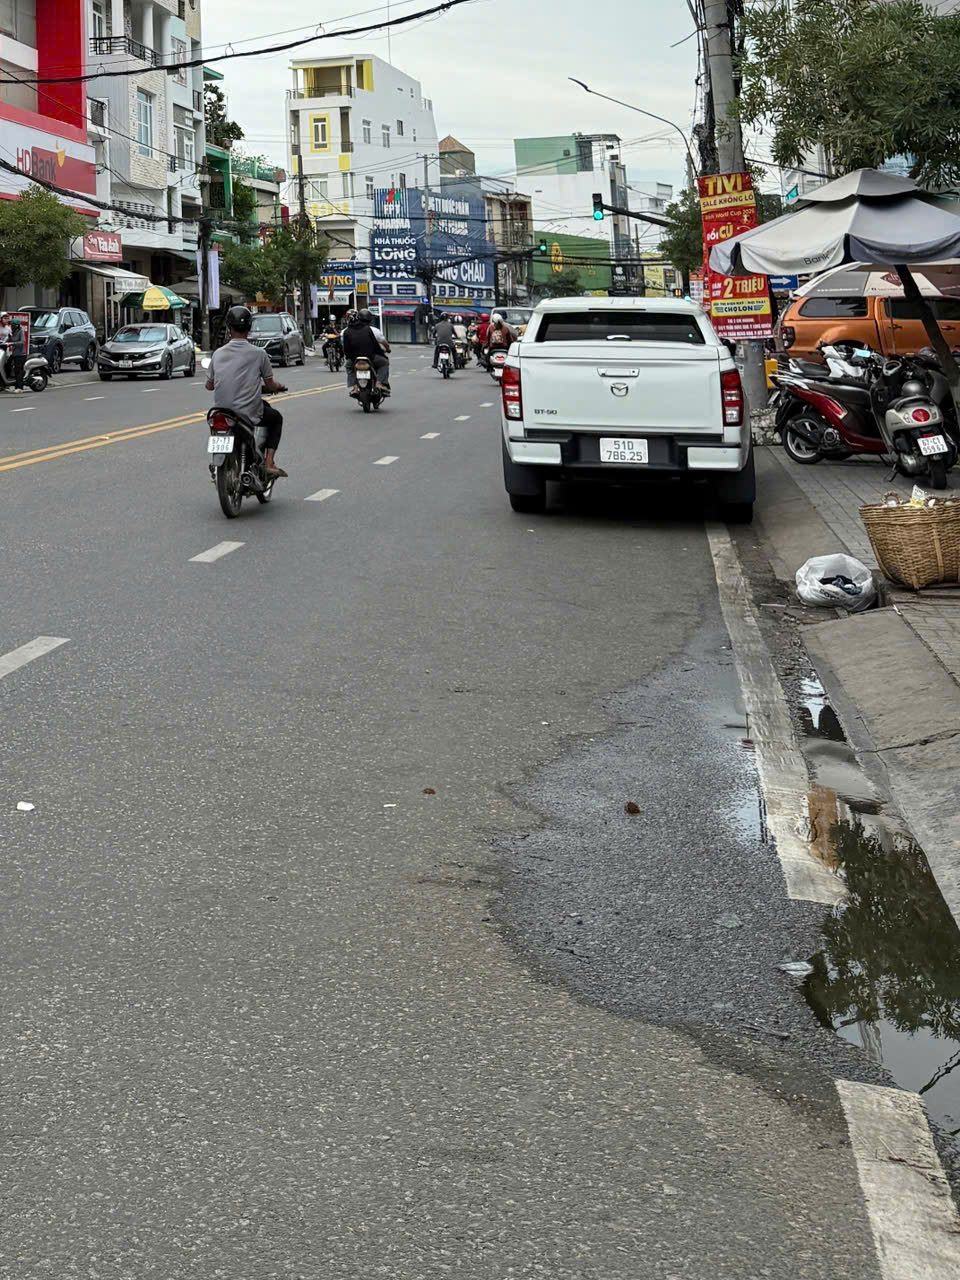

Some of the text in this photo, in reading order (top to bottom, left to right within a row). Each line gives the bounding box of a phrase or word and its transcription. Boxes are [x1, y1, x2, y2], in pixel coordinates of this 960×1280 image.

[16, 147, 57, 181] HDBank
[705, 174, 743, 196] TIVI
[383, 204, 400, 216] FPT
[373, 218, 410, 229] PHARMA
[374, 248, 416, 261] LONG
[804, 253, 830, 266] Bank
[460, 259, 486, 283] CHÂU
[723, 276, 765, 299] 2 TRIỆU
[613, 440, 634, 451] 51D
[606, 450, 643, 461] 786.25
